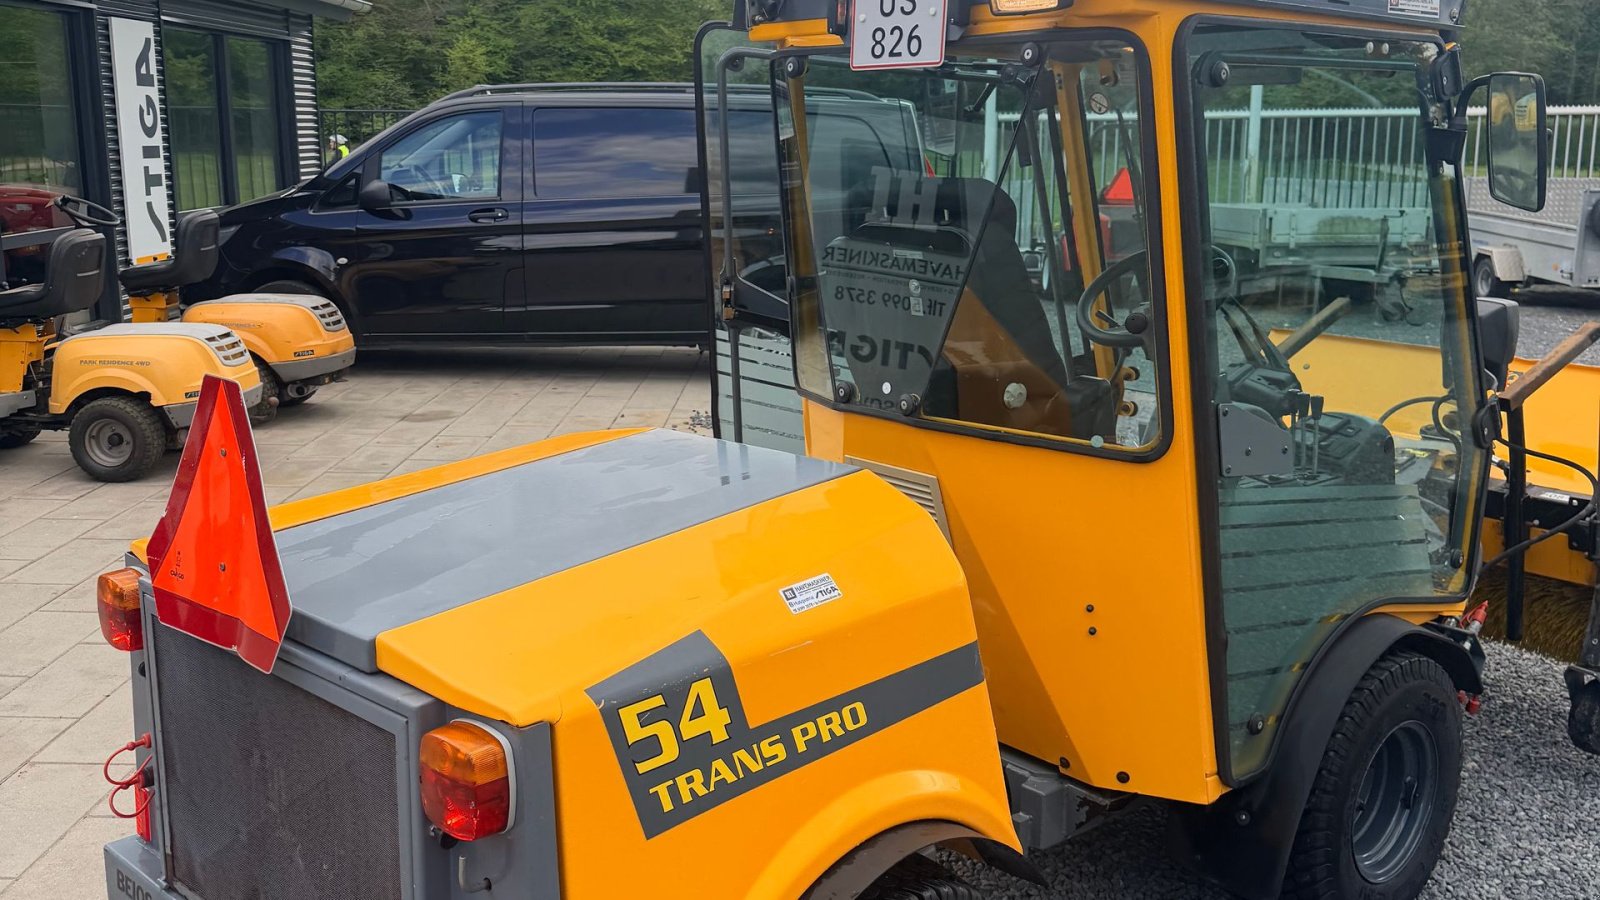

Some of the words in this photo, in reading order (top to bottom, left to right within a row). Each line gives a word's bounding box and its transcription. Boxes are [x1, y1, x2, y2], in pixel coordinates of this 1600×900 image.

[871, 24, 922, 59] 826
[880, 0, 917, 17] US
[135, 37, 167, 242] STIGA
[816, 586, 838, 599] STIGA
[617, 676, 732, 776] 54
[648, 734, 788, 814] TRANS
[791, 701, 868, 754] PRO
